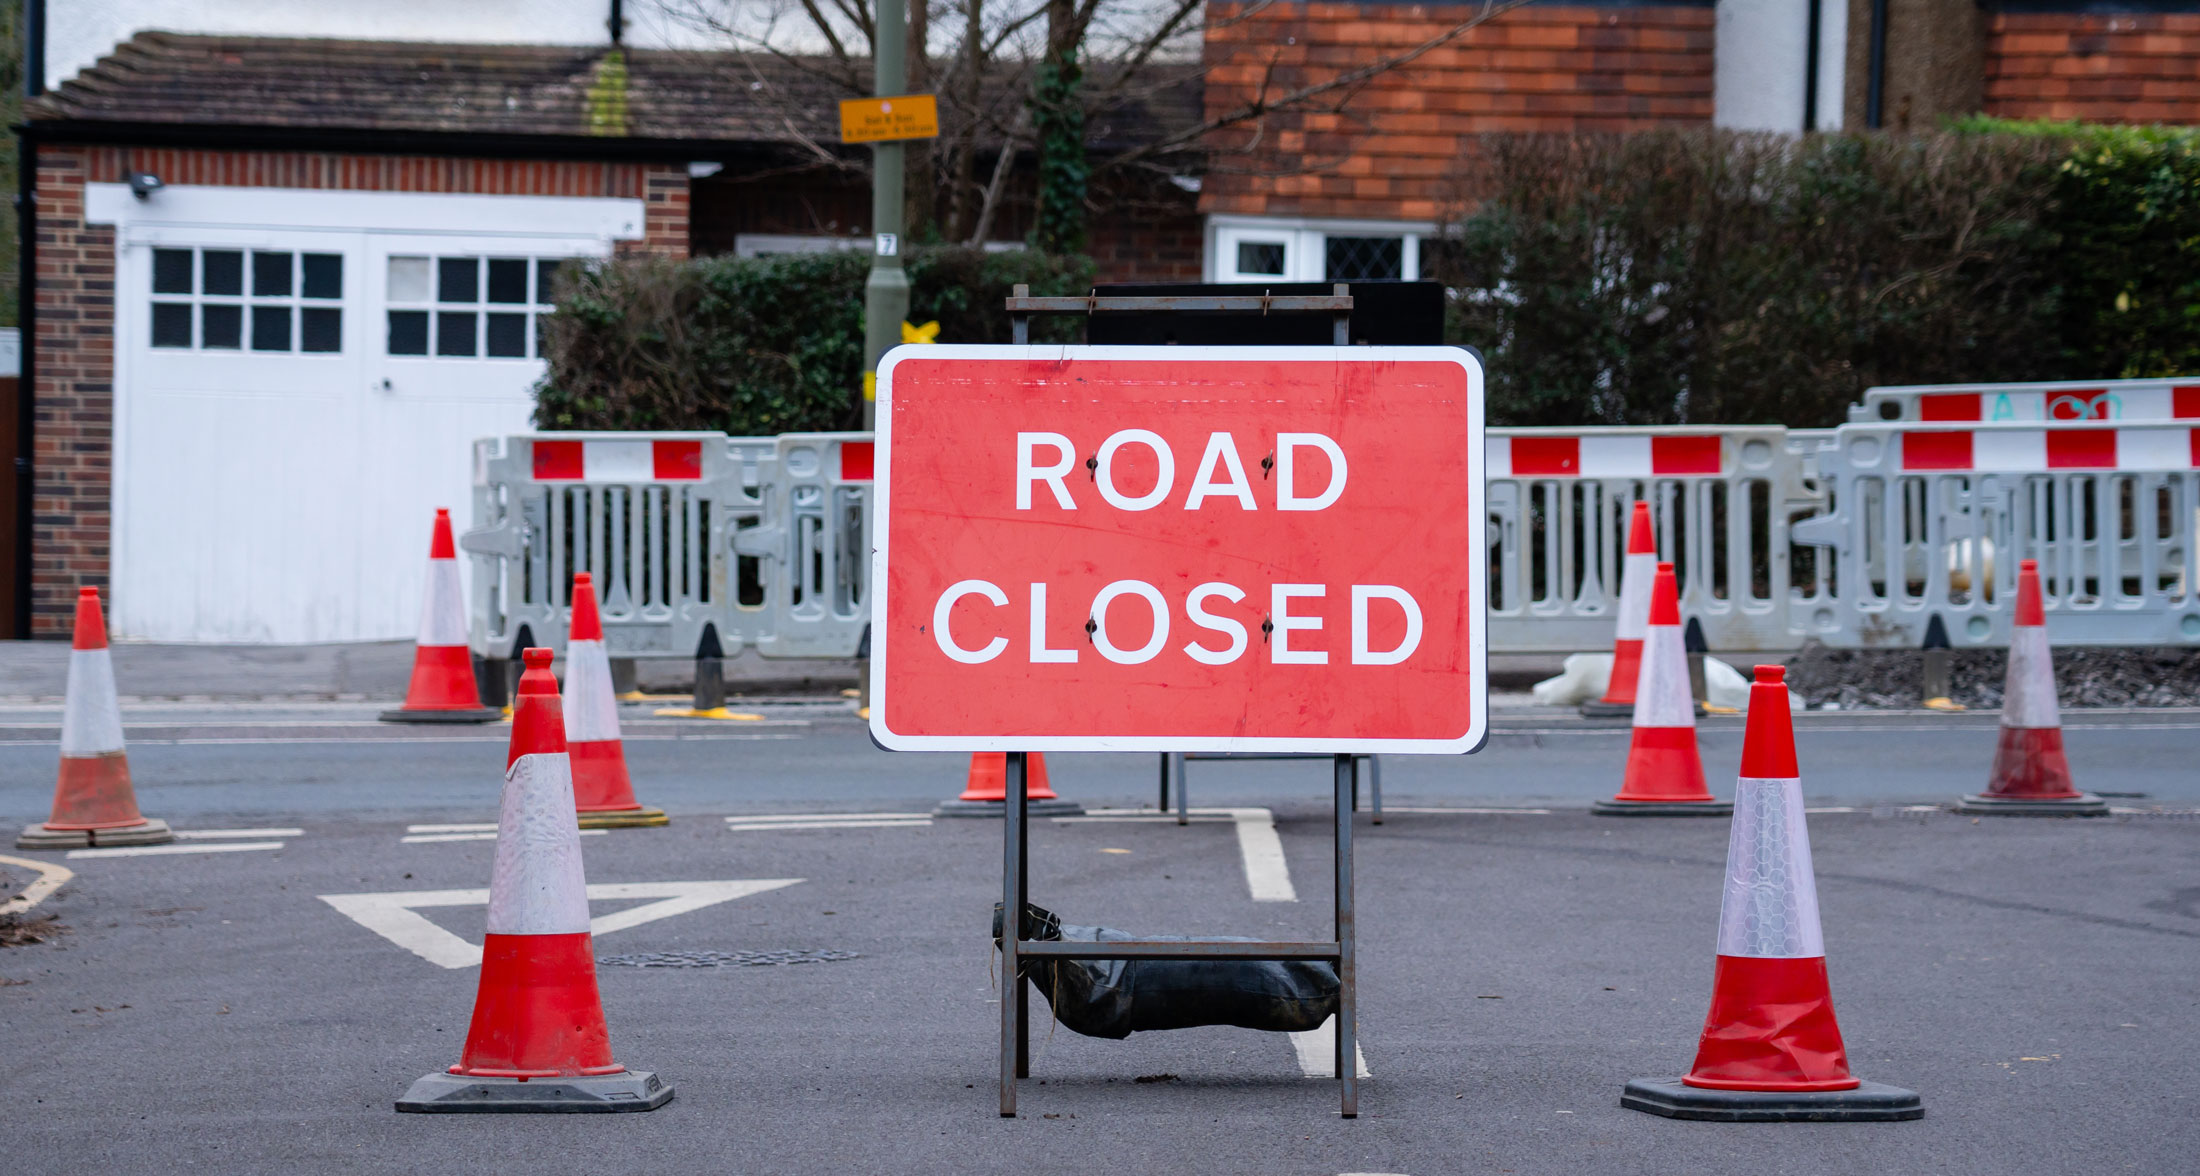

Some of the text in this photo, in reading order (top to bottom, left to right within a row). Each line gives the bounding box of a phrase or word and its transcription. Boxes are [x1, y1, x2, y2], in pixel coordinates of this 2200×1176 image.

[882, 235, 892, 255] 7
[1016, 429, 1348, 511] ROAD
[932, 579, 1423, 665] CLOSED
